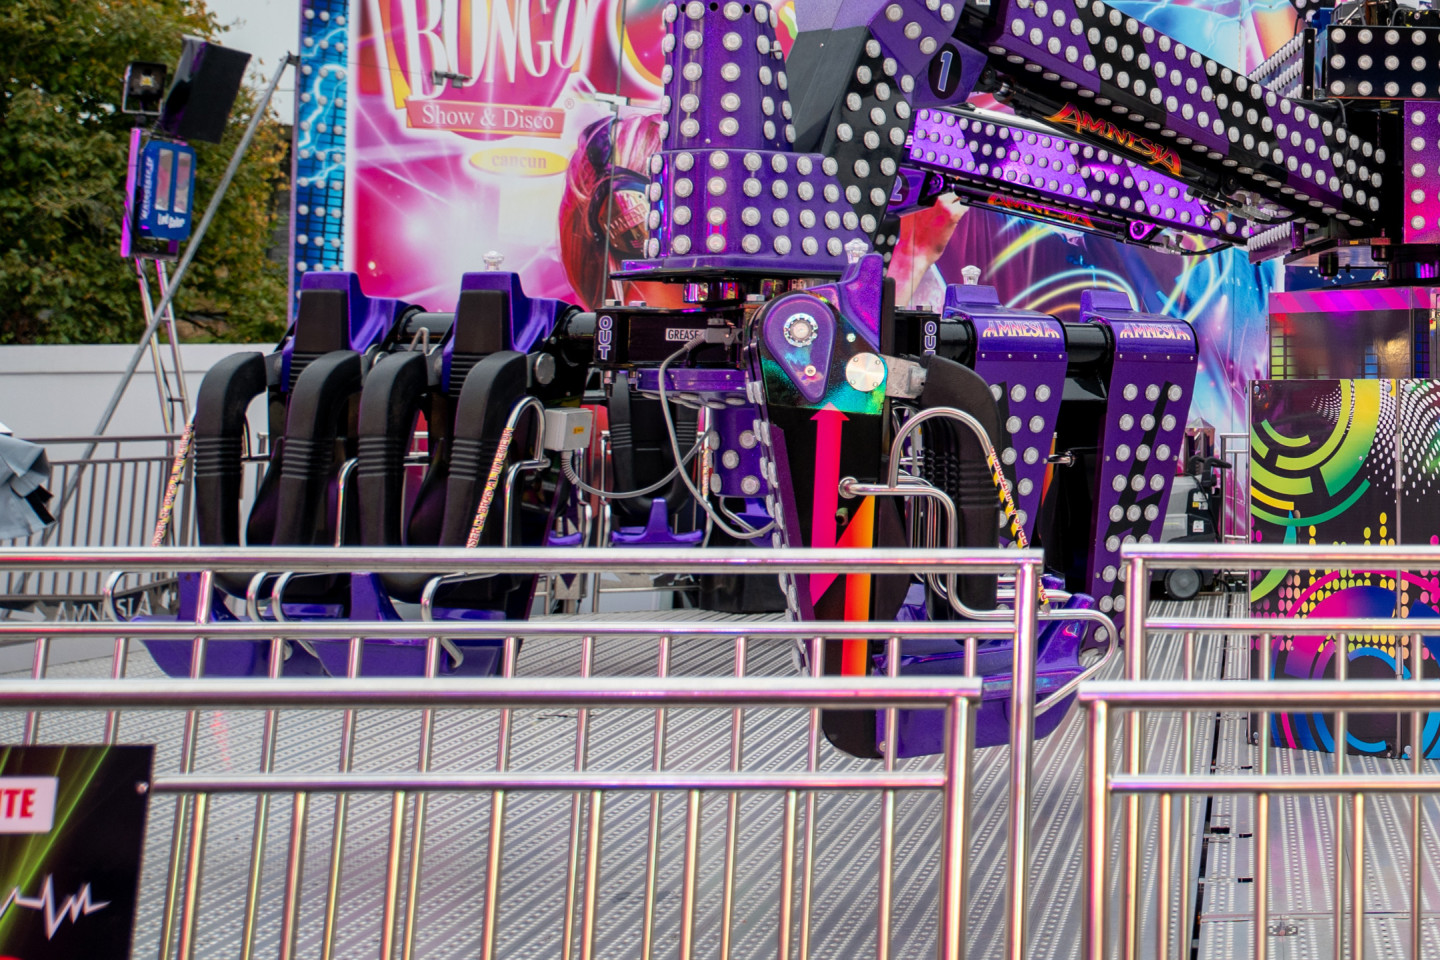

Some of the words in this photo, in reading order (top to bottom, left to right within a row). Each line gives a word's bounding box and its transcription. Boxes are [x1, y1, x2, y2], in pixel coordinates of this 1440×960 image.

[938, 50, 953, 92] 1
[422, 104, 475, 126] Show
[480, 109, 496, 127] &
[504, 109, 554, 129] Disco
[1042, 101, 1184, 177] AMNESIA
[491, 154, 547, 169] cancun
[598, 315, 613, 360] OUT
[982, 320, 1060, 338] AMNESIA
[1119, 323, 1191, 340] AMNESIA
[0, 788, 36, 819] TE
